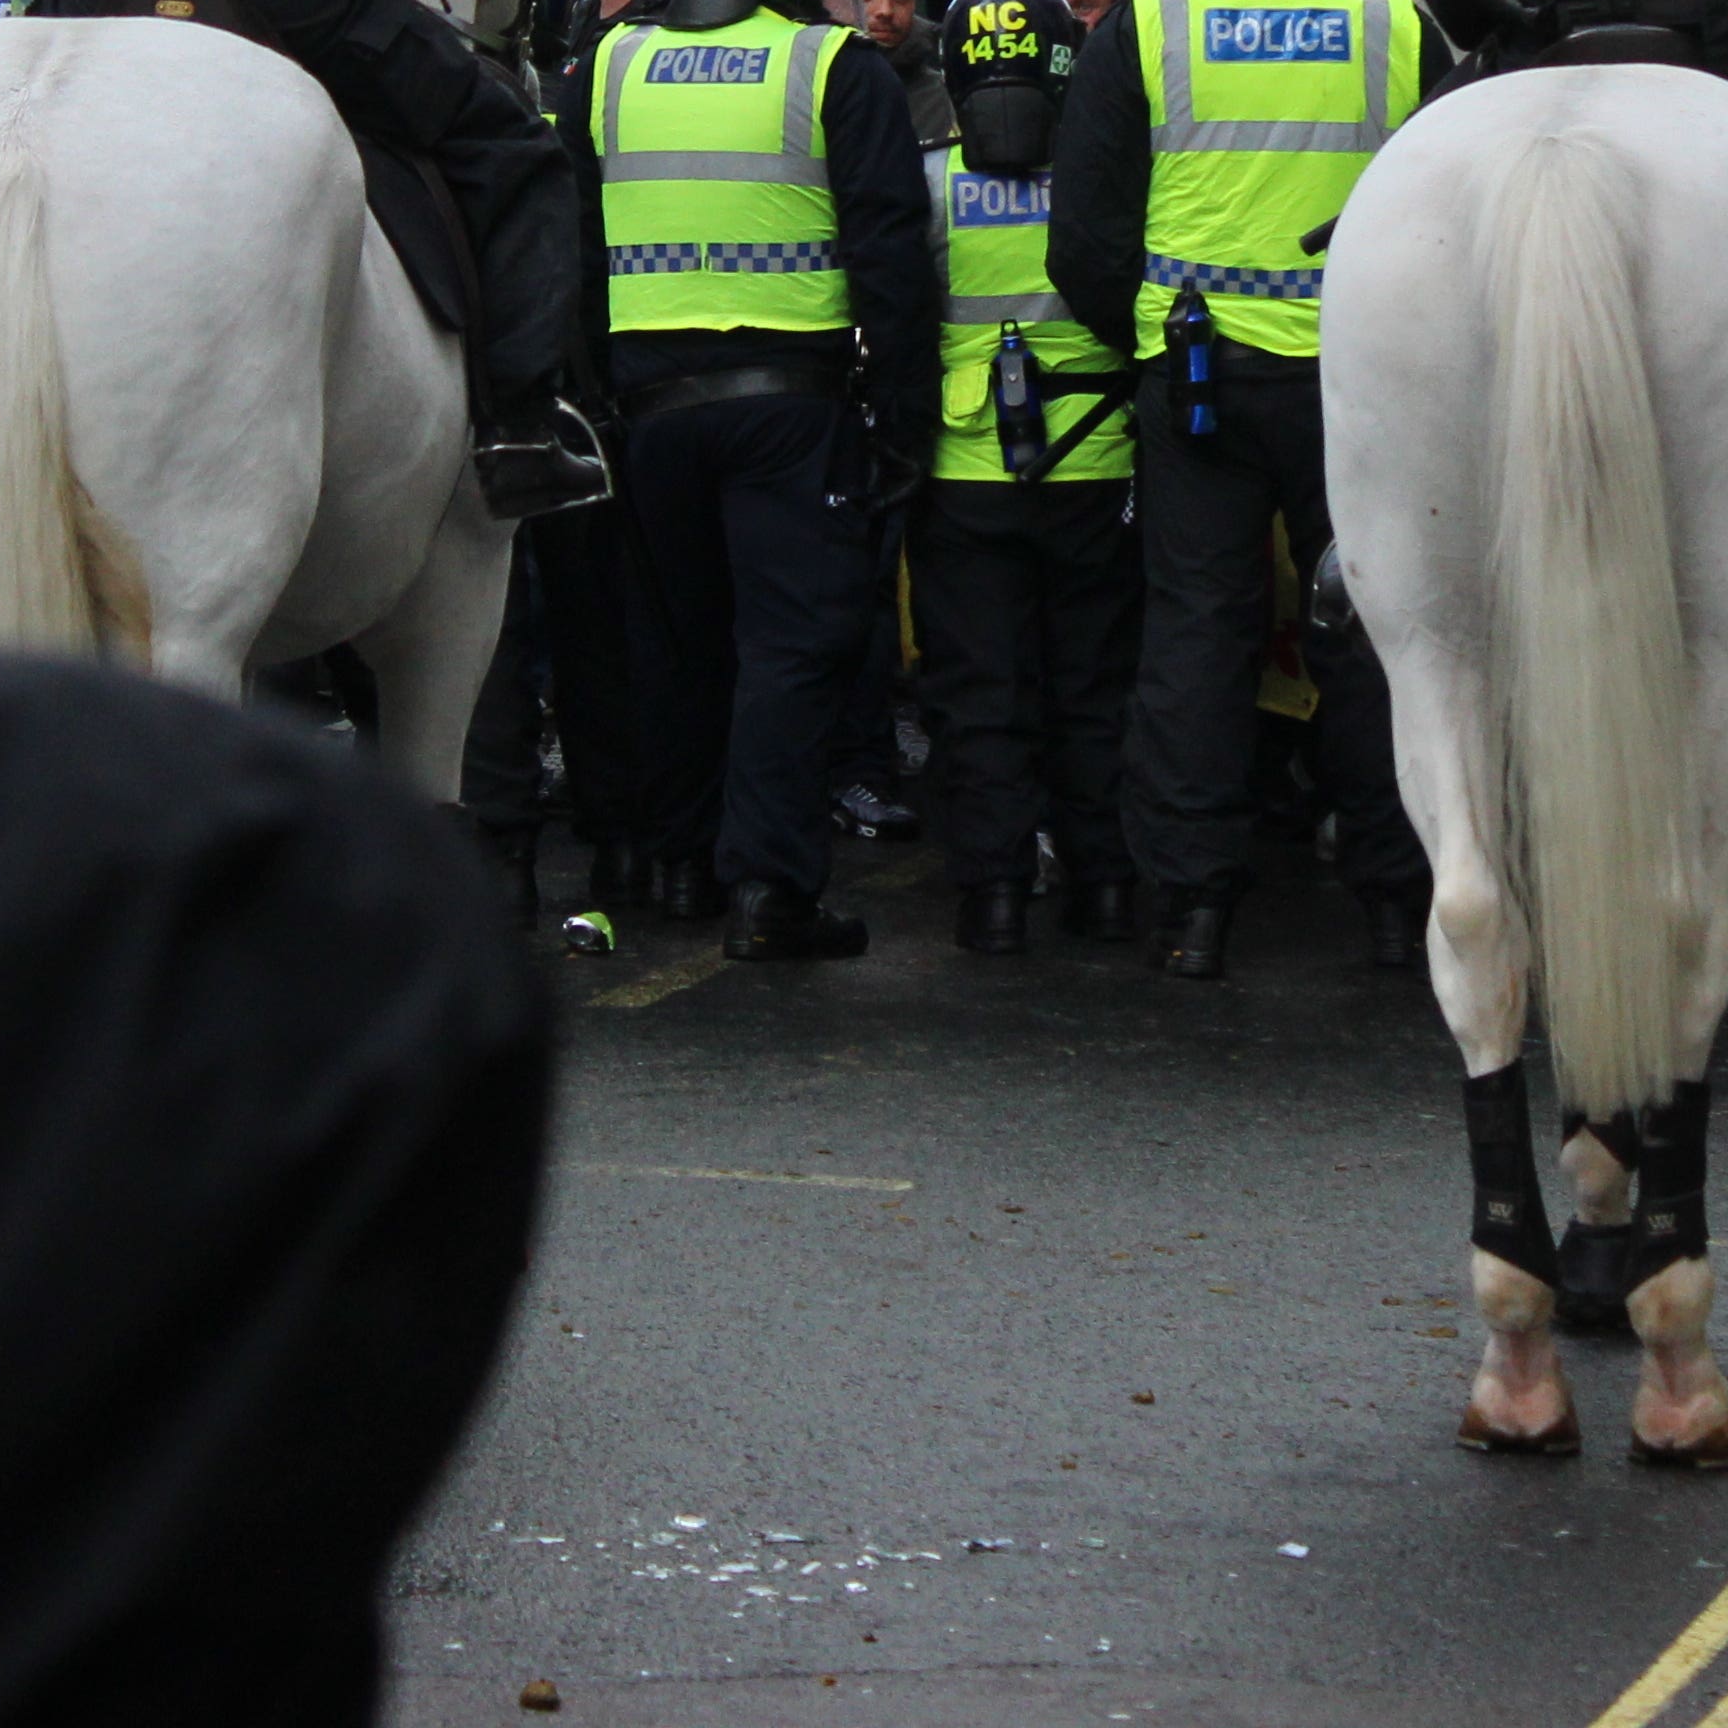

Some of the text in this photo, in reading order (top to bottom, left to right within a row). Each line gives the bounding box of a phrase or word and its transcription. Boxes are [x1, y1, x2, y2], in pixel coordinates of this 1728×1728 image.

[969, 1, 1027, 34] NC
[1209, 14, 1345, 54] POLICE
[652, 48, 765, 82] POLICE
[961, 32, 1039, 64] 1454
[957, 180, 1051, 217] POLI
